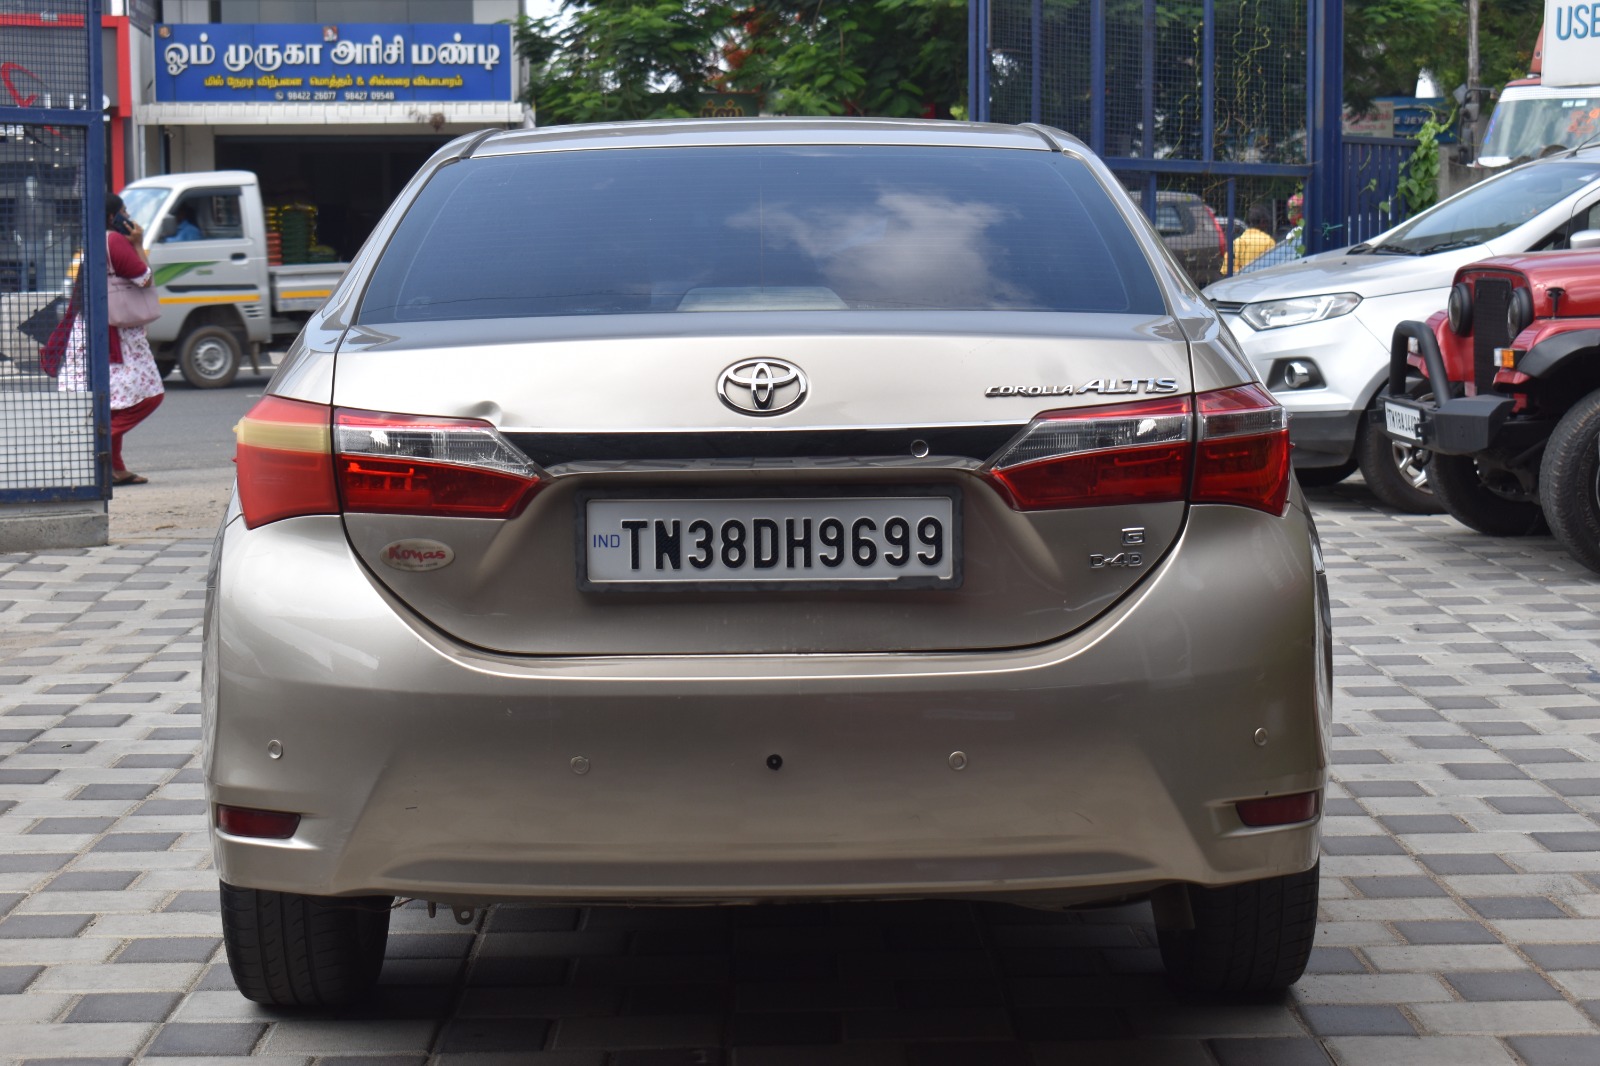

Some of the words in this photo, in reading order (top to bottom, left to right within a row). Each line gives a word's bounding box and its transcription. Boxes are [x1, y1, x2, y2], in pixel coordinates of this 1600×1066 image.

[165, 32, 216, 76] ஓம்
[224, 43, 323, 72] முருகா
[330, 34, 404, 65] அரிசி
[411, 32, 500, 70] மண்டி
[984, 384, 1074, 397] COROLLA
[1075, 377, 1180, 395] ALTIS
[593, 534, 621, 548] IND
[620, 515, 944, 571] TN38DH9699
[1089, 552, 1143, 568] D-4D
